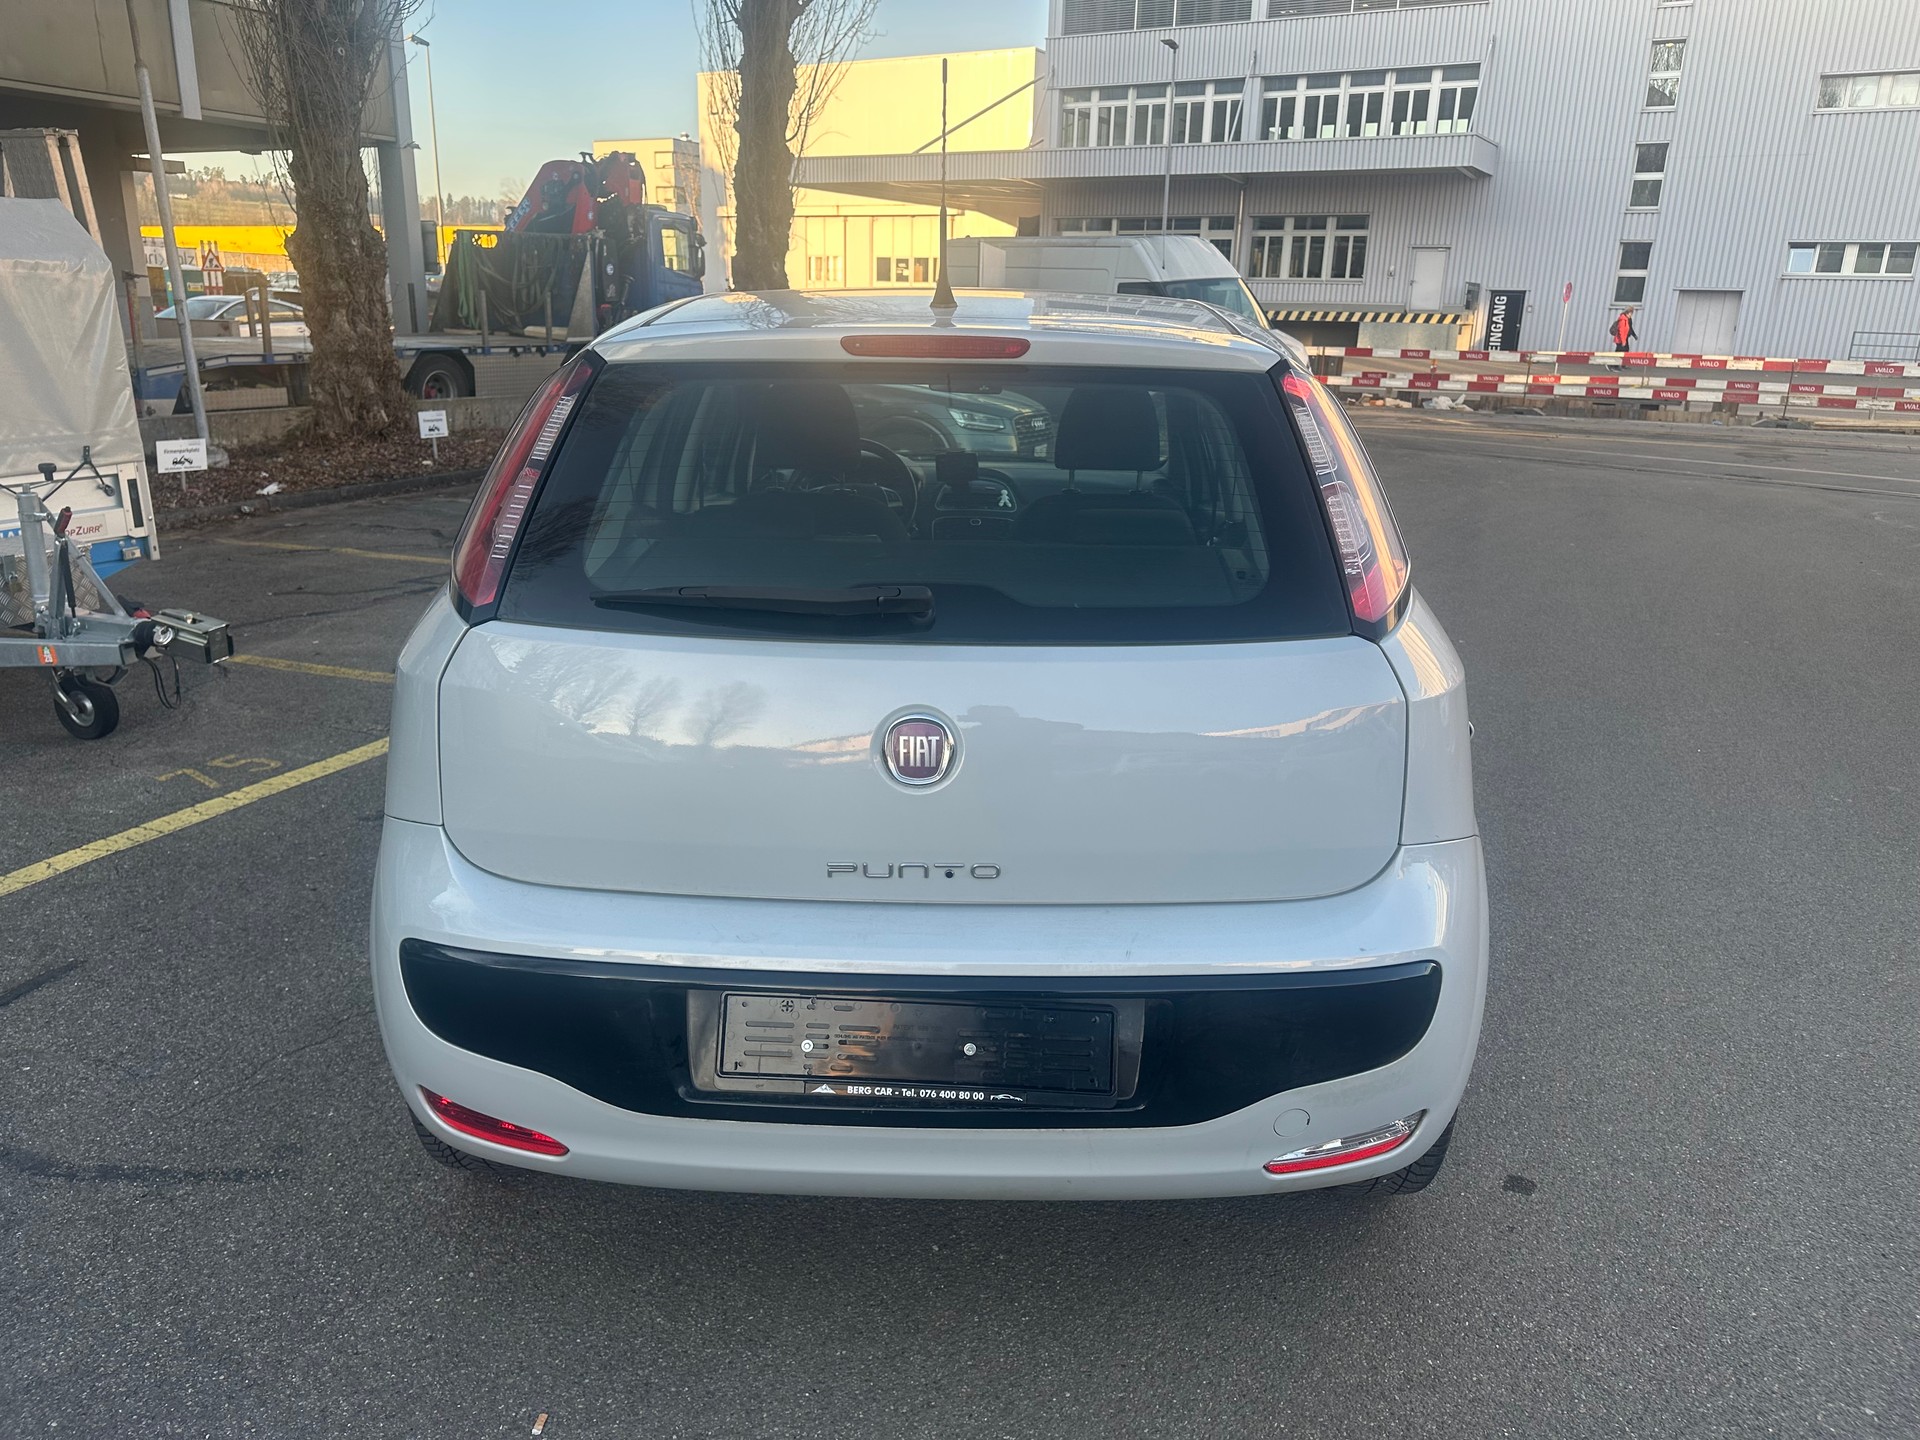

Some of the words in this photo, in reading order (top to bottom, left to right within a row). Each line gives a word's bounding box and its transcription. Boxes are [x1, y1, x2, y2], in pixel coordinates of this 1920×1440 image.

[1488, 295, 1507, 352] EINGANG
[1407, 349, 1424, 358] WALO
[1465, 352, 1484, 360] WALO
[1629, 358, 1649, 366] WALO
[1699, 360, 1720, 368] WALO
[1593, 388, 1612, 396] WALO
[1659, 391, 1680, 399] WALO
[899, 735, 940, 768] FIAT
[826, 861, 1001, 879] PUNTO
[847, 1085, 872, 1095] BERG
[874, 1086, 893, 1096] CAR
[902, 1088, 917, 1097] Tel.
[919, 1089, 937, 1098] 076
[938, 1090, 957, 1099] 400
[958, 1091, 971, 1100] 80
[972, 1091, 985, 1101] 00
